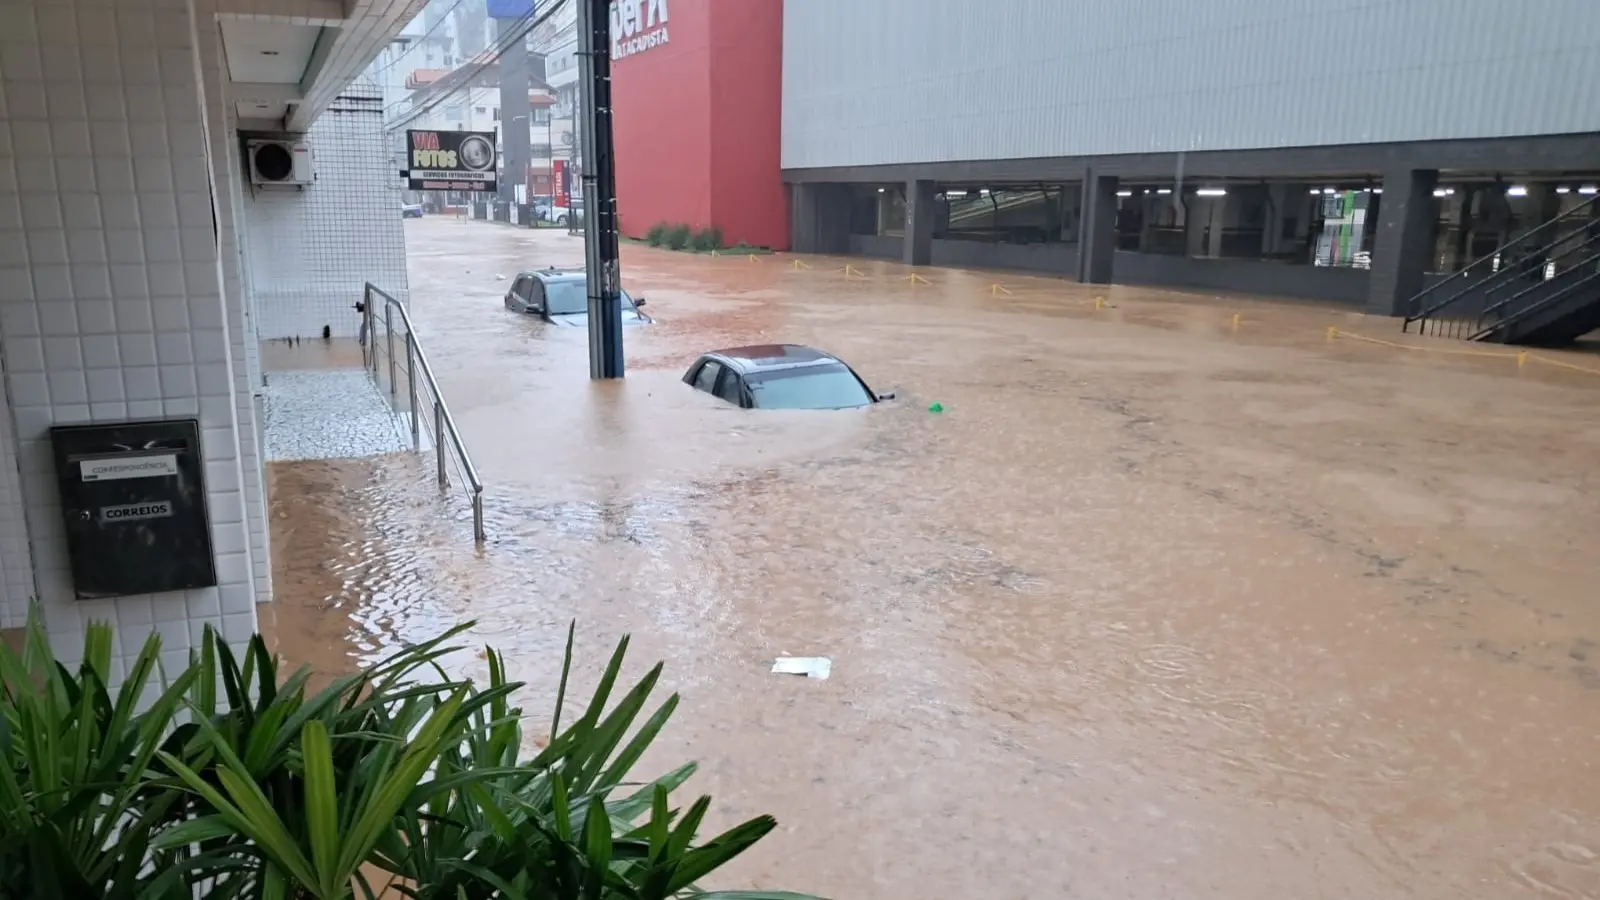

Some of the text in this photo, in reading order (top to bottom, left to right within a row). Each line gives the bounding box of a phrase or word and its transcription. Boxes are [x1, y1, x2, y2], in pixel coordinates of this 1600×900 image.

[609, 0, 668, 60] per
[616, 27, 669, 58] ATACADISTA
[412, 132, 440, 149] VIA
[413, 149, 457, 168] FOTOS
[106, 504, 168, 519] CORREIOS
